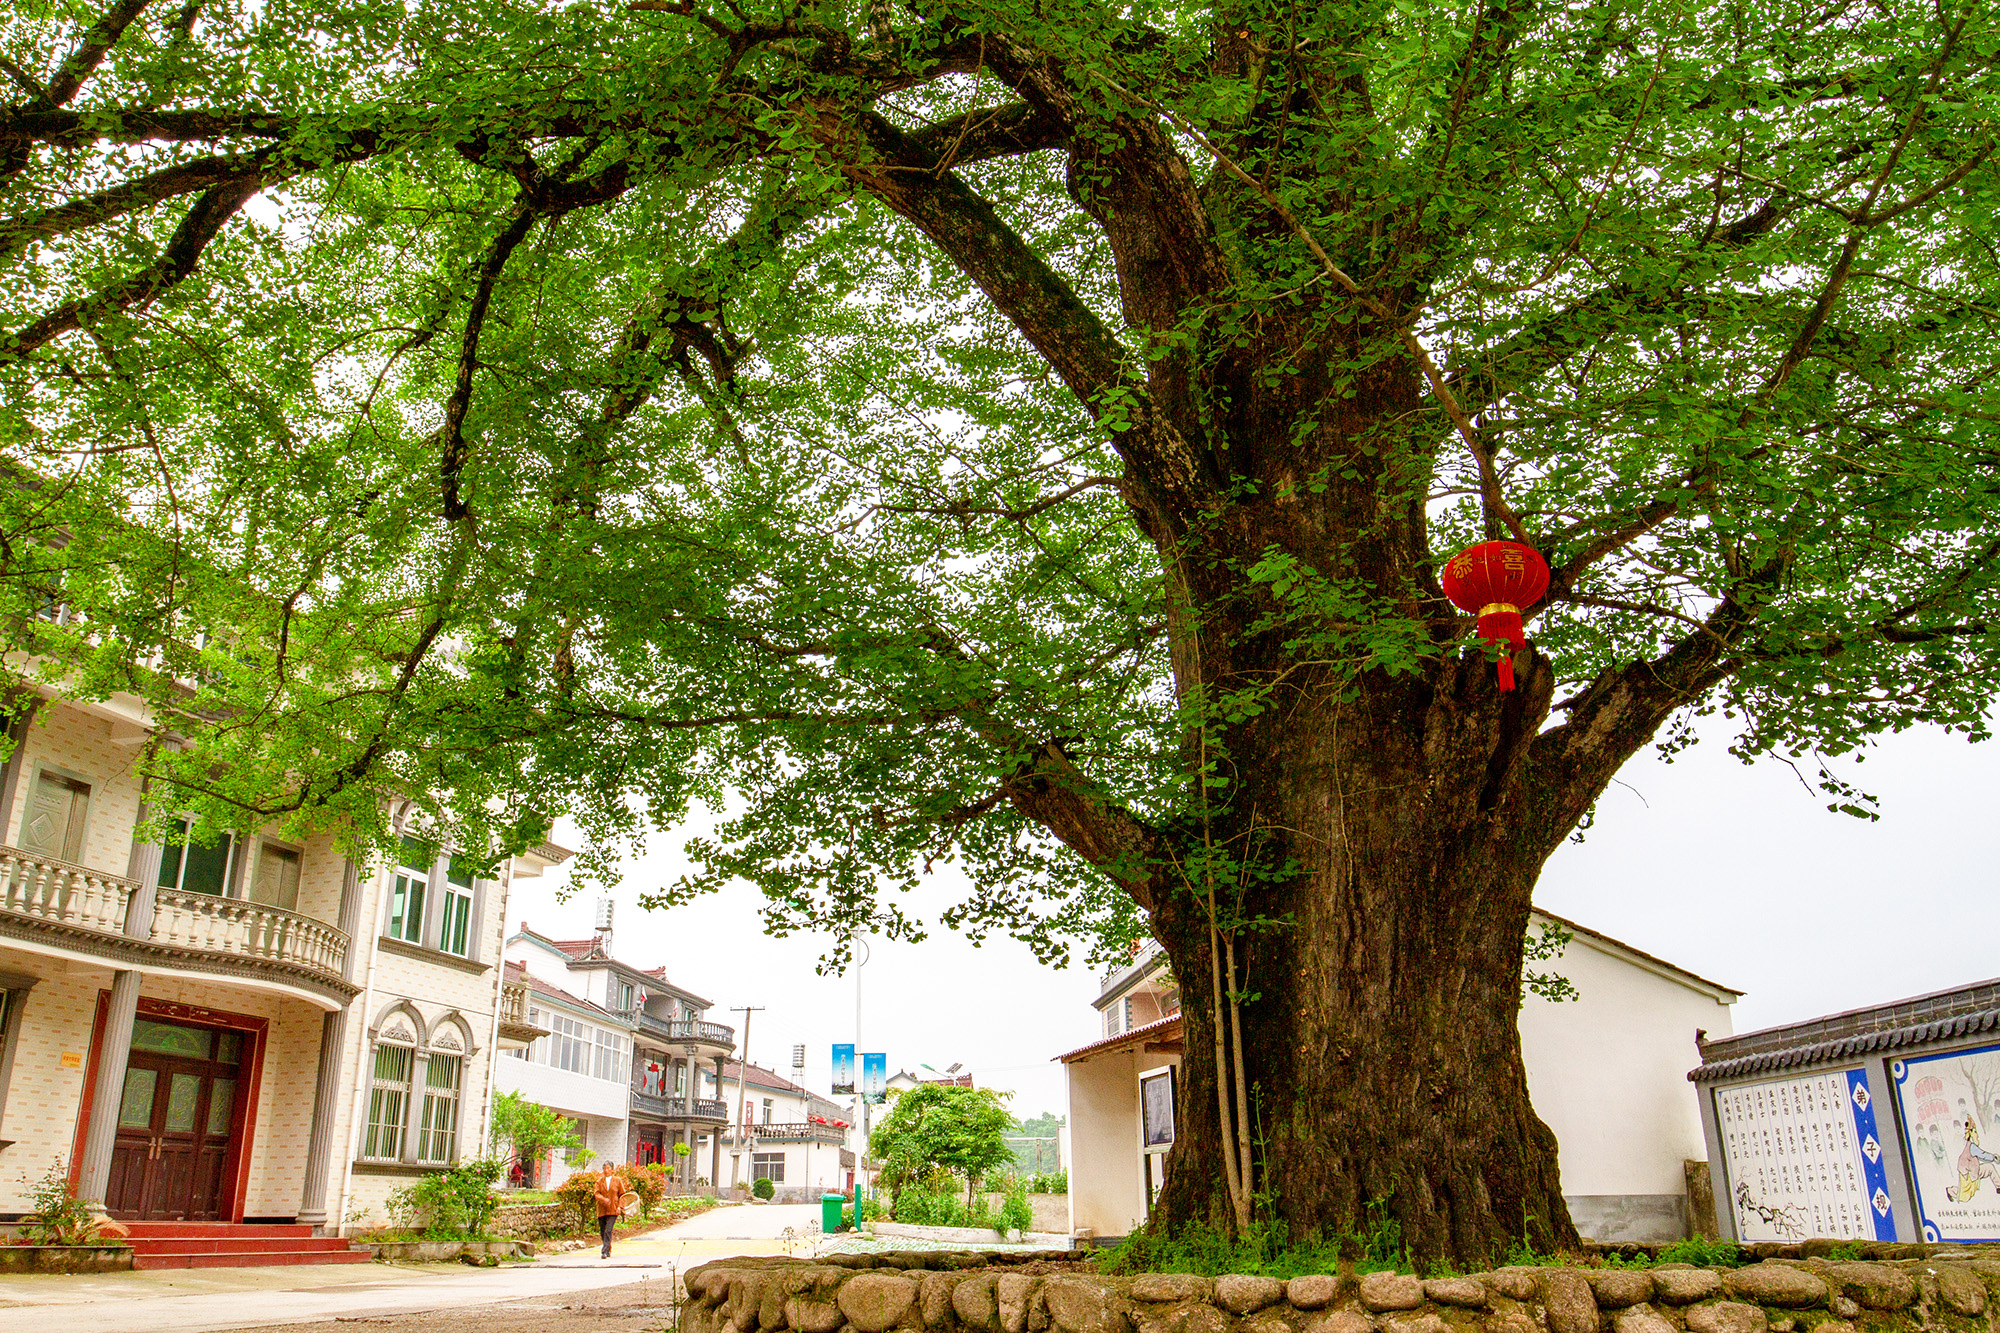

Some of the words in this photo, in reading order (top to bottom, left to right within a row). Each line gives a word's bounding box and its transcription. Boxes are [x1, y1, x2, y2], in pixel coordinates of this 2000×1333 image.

[1856, 1089, 1889, 1211] 弟子规
[1806, 1164, 1817, 1192] 不如人
[1818, 1163, 1830, 1192] 不如人
